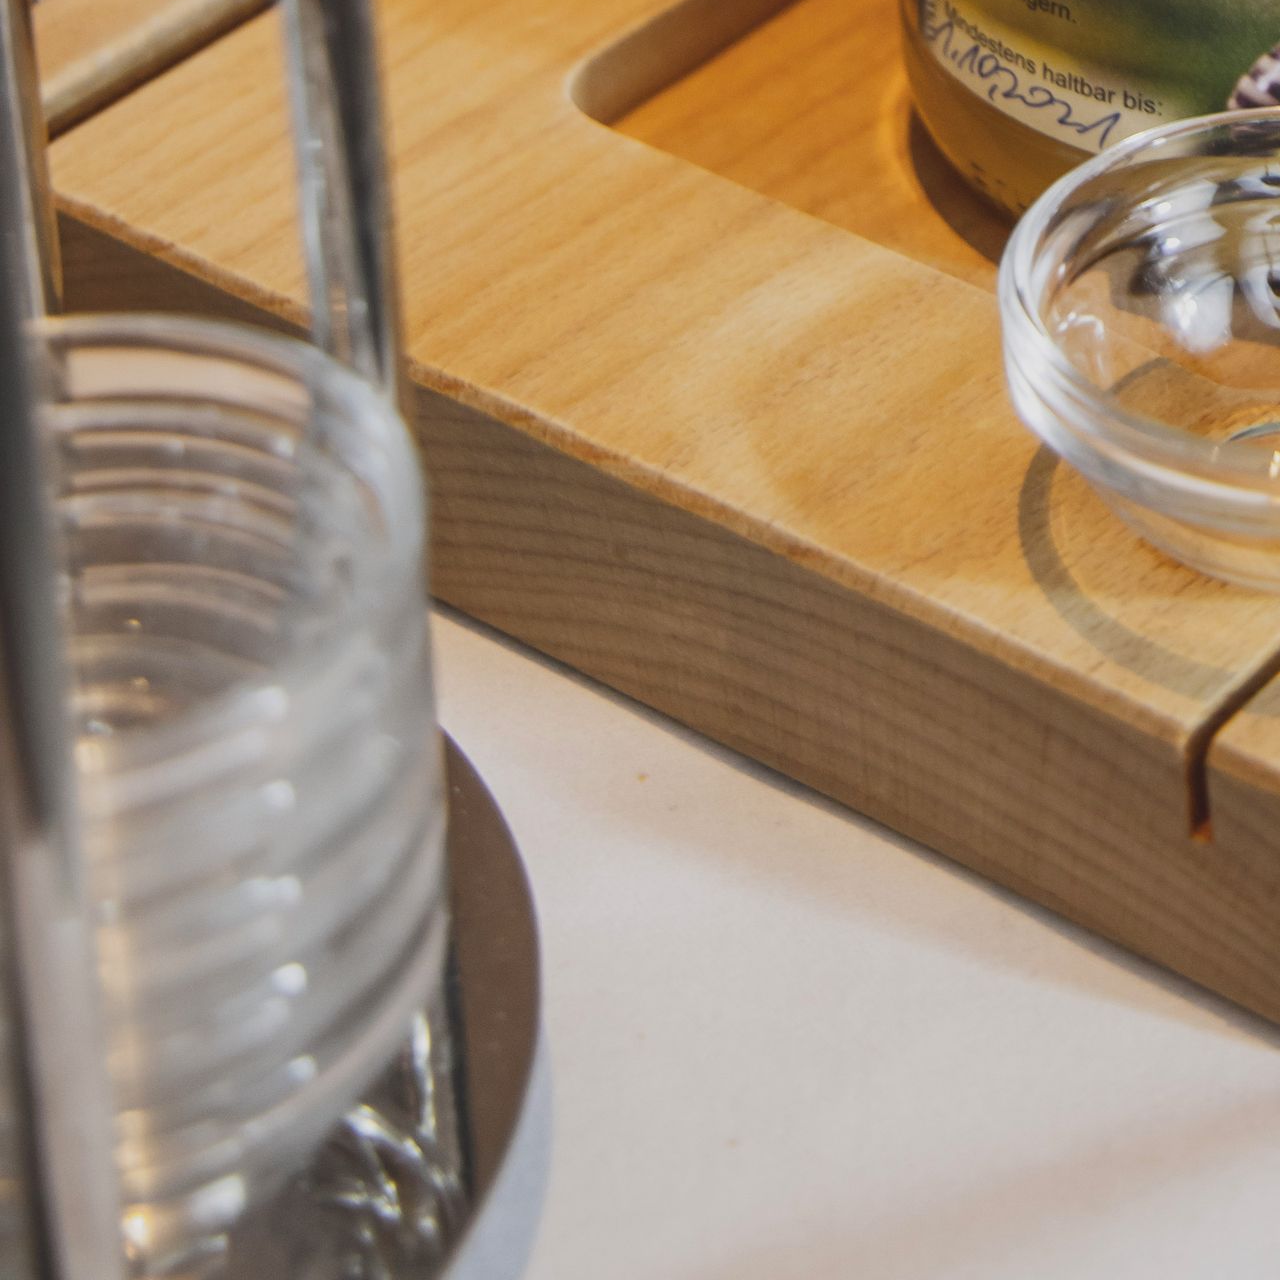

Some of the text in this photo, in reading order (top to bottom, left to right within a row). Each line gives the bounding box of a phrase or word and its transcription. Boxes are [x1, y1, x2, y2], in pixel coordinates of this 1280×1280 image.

[944, 0, 1164, 117] Mindestens haltbar bis:
